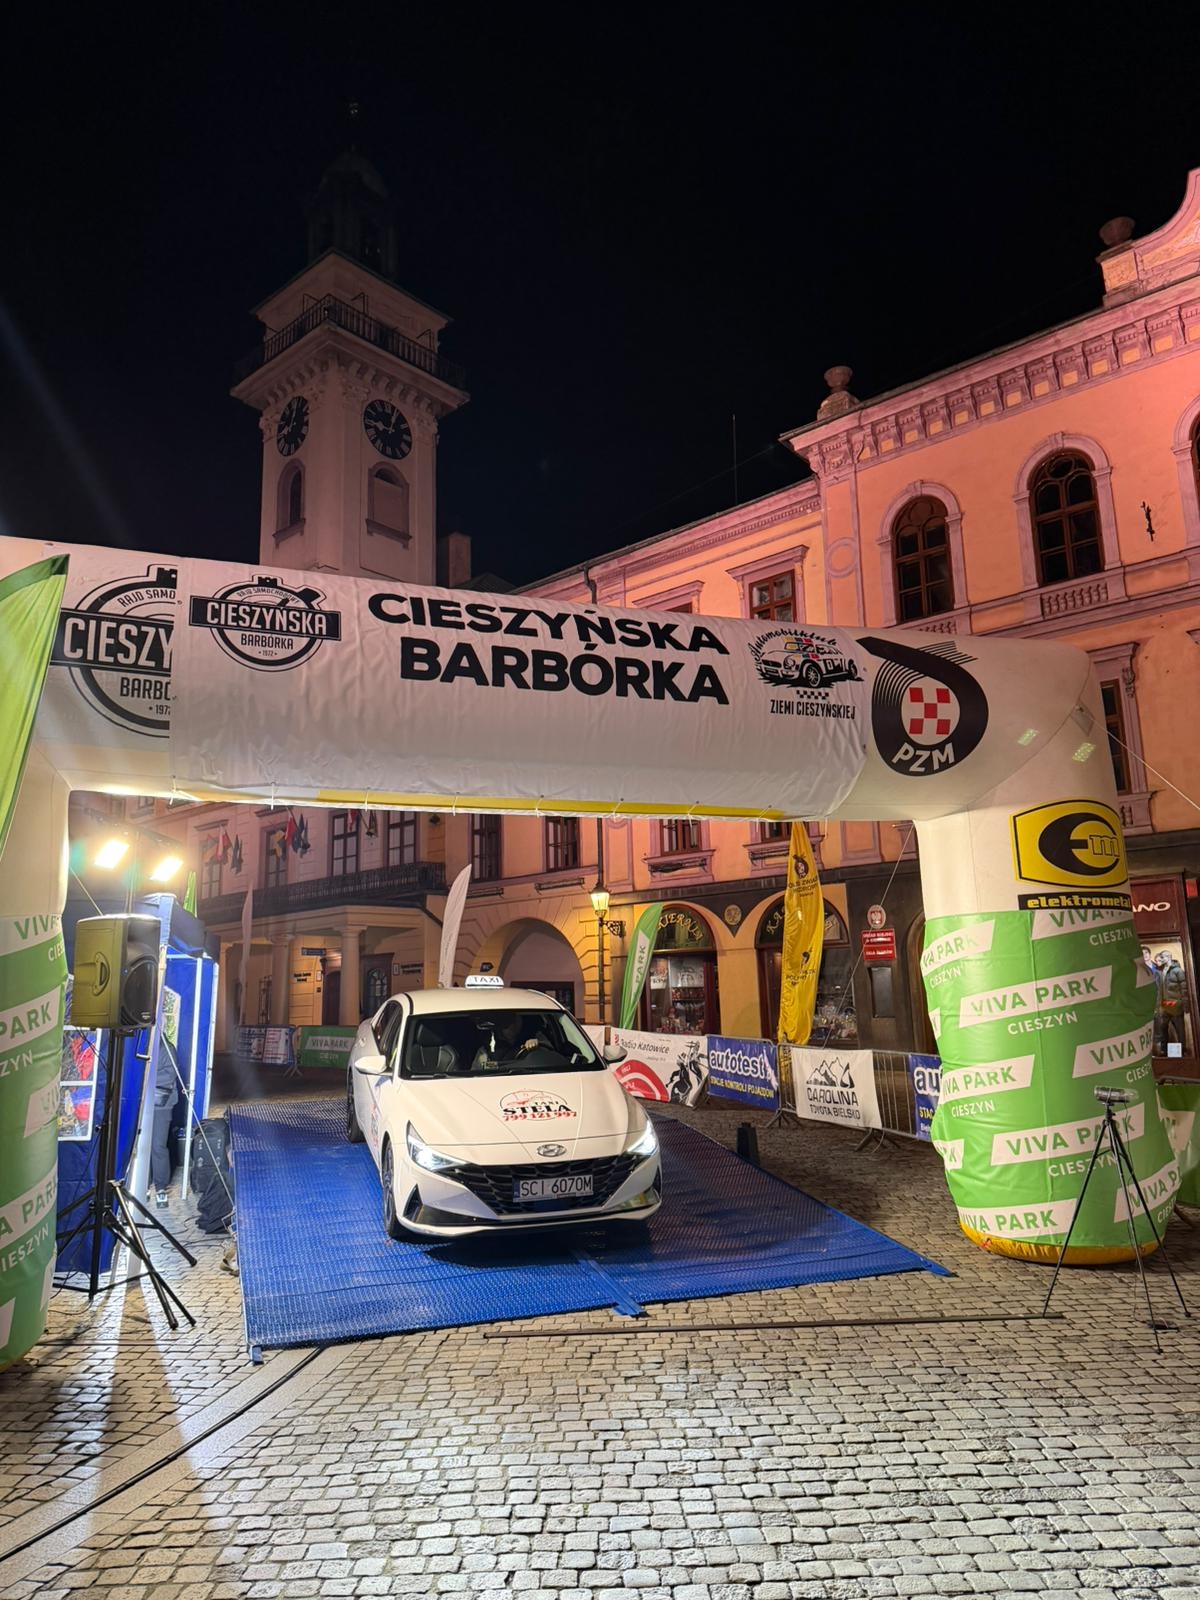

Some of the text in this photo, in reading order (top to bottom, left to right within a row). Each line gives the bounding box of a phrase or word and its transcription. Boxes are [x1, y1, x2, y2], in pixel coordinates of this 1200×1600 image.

[117, 589, 175, 607] RAJD SAMO
[206, 601, 327, 635] CIESZYŃSKA
[368, 593, 730, 654] CIESZYŃSKA
[63, 617, 175, 669] CIESZY
[241, 633, 293, 650] BARBÓRKA
[400, 636, 730, 705] BARBÓRKA
[770, 700, 856, 720] ZIEMI CIESZYŃSKIEJ
[891, 742, 955, 772] PZM
[1089, 928, 1132, 947] CIESZYN
[970, 976, 1099, 1016] VIVA PARK
[1007, 1011, 1078, 1035] CIESZYN
[638, 1041, 670, 1054] Katowice
[1090, 1039, 1137, 1065] VIVA
[710, 1048, 765, 1079] autotest
[963, 1066, 1017, 1090] PARK
[807, 1087, 859, 1106] CAROLINA
[810, 1104, 861, 1119] TOYOTA BIELSKO
[950, 1099, 996, 1118] CIESZYN
[1006, 1132, 1069, 1155] VIVA
[521, 1176, 592, 1197] SCI 6070M
[995, 1209, 1058, 1231] PARK
